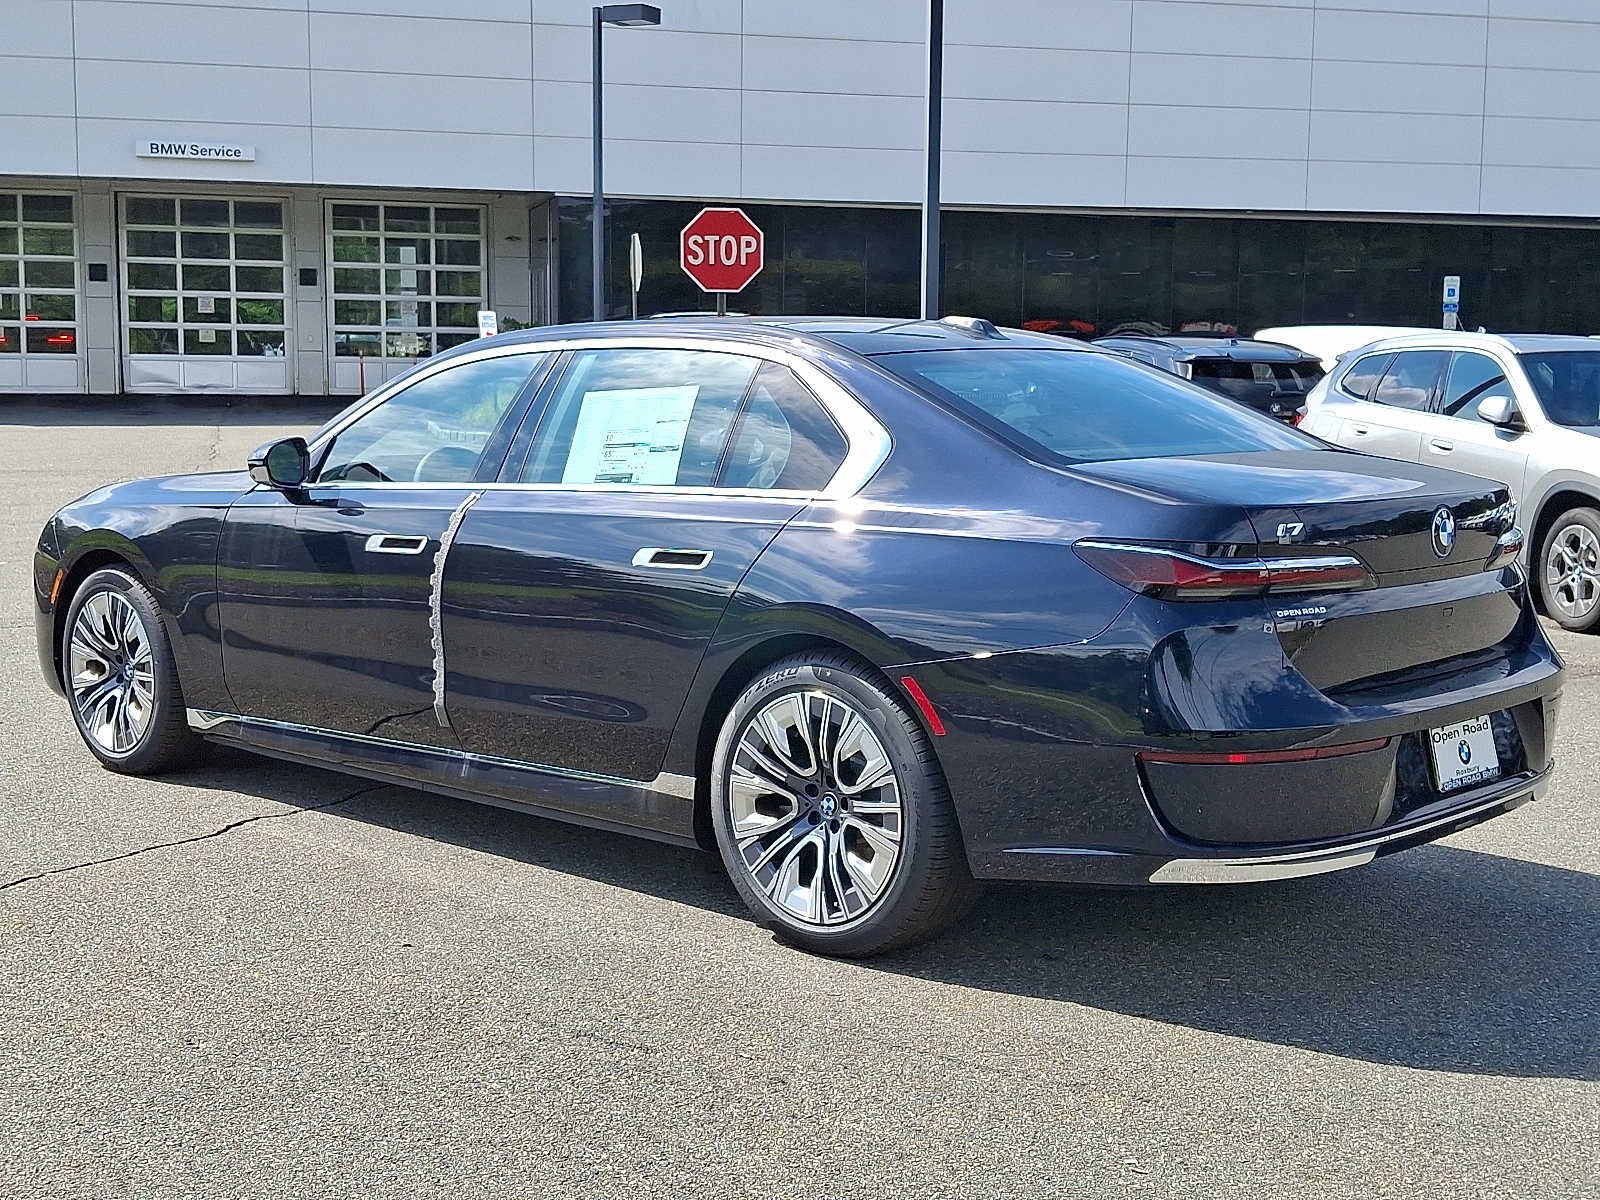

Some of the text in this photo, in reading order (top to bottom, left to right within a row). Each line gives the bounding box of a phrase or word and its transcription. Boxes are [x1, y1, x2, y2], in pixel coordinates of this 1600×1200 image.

[149, 142, 242, 158] BMW Service
[687, 234, 758, 266] STOP
[1276, 606, 1327, 618] OPEN ROAD
[1432, 719, 1490, 745] Open Road
[1443, 767, 1498, 791] OPEN ROAD BMW
